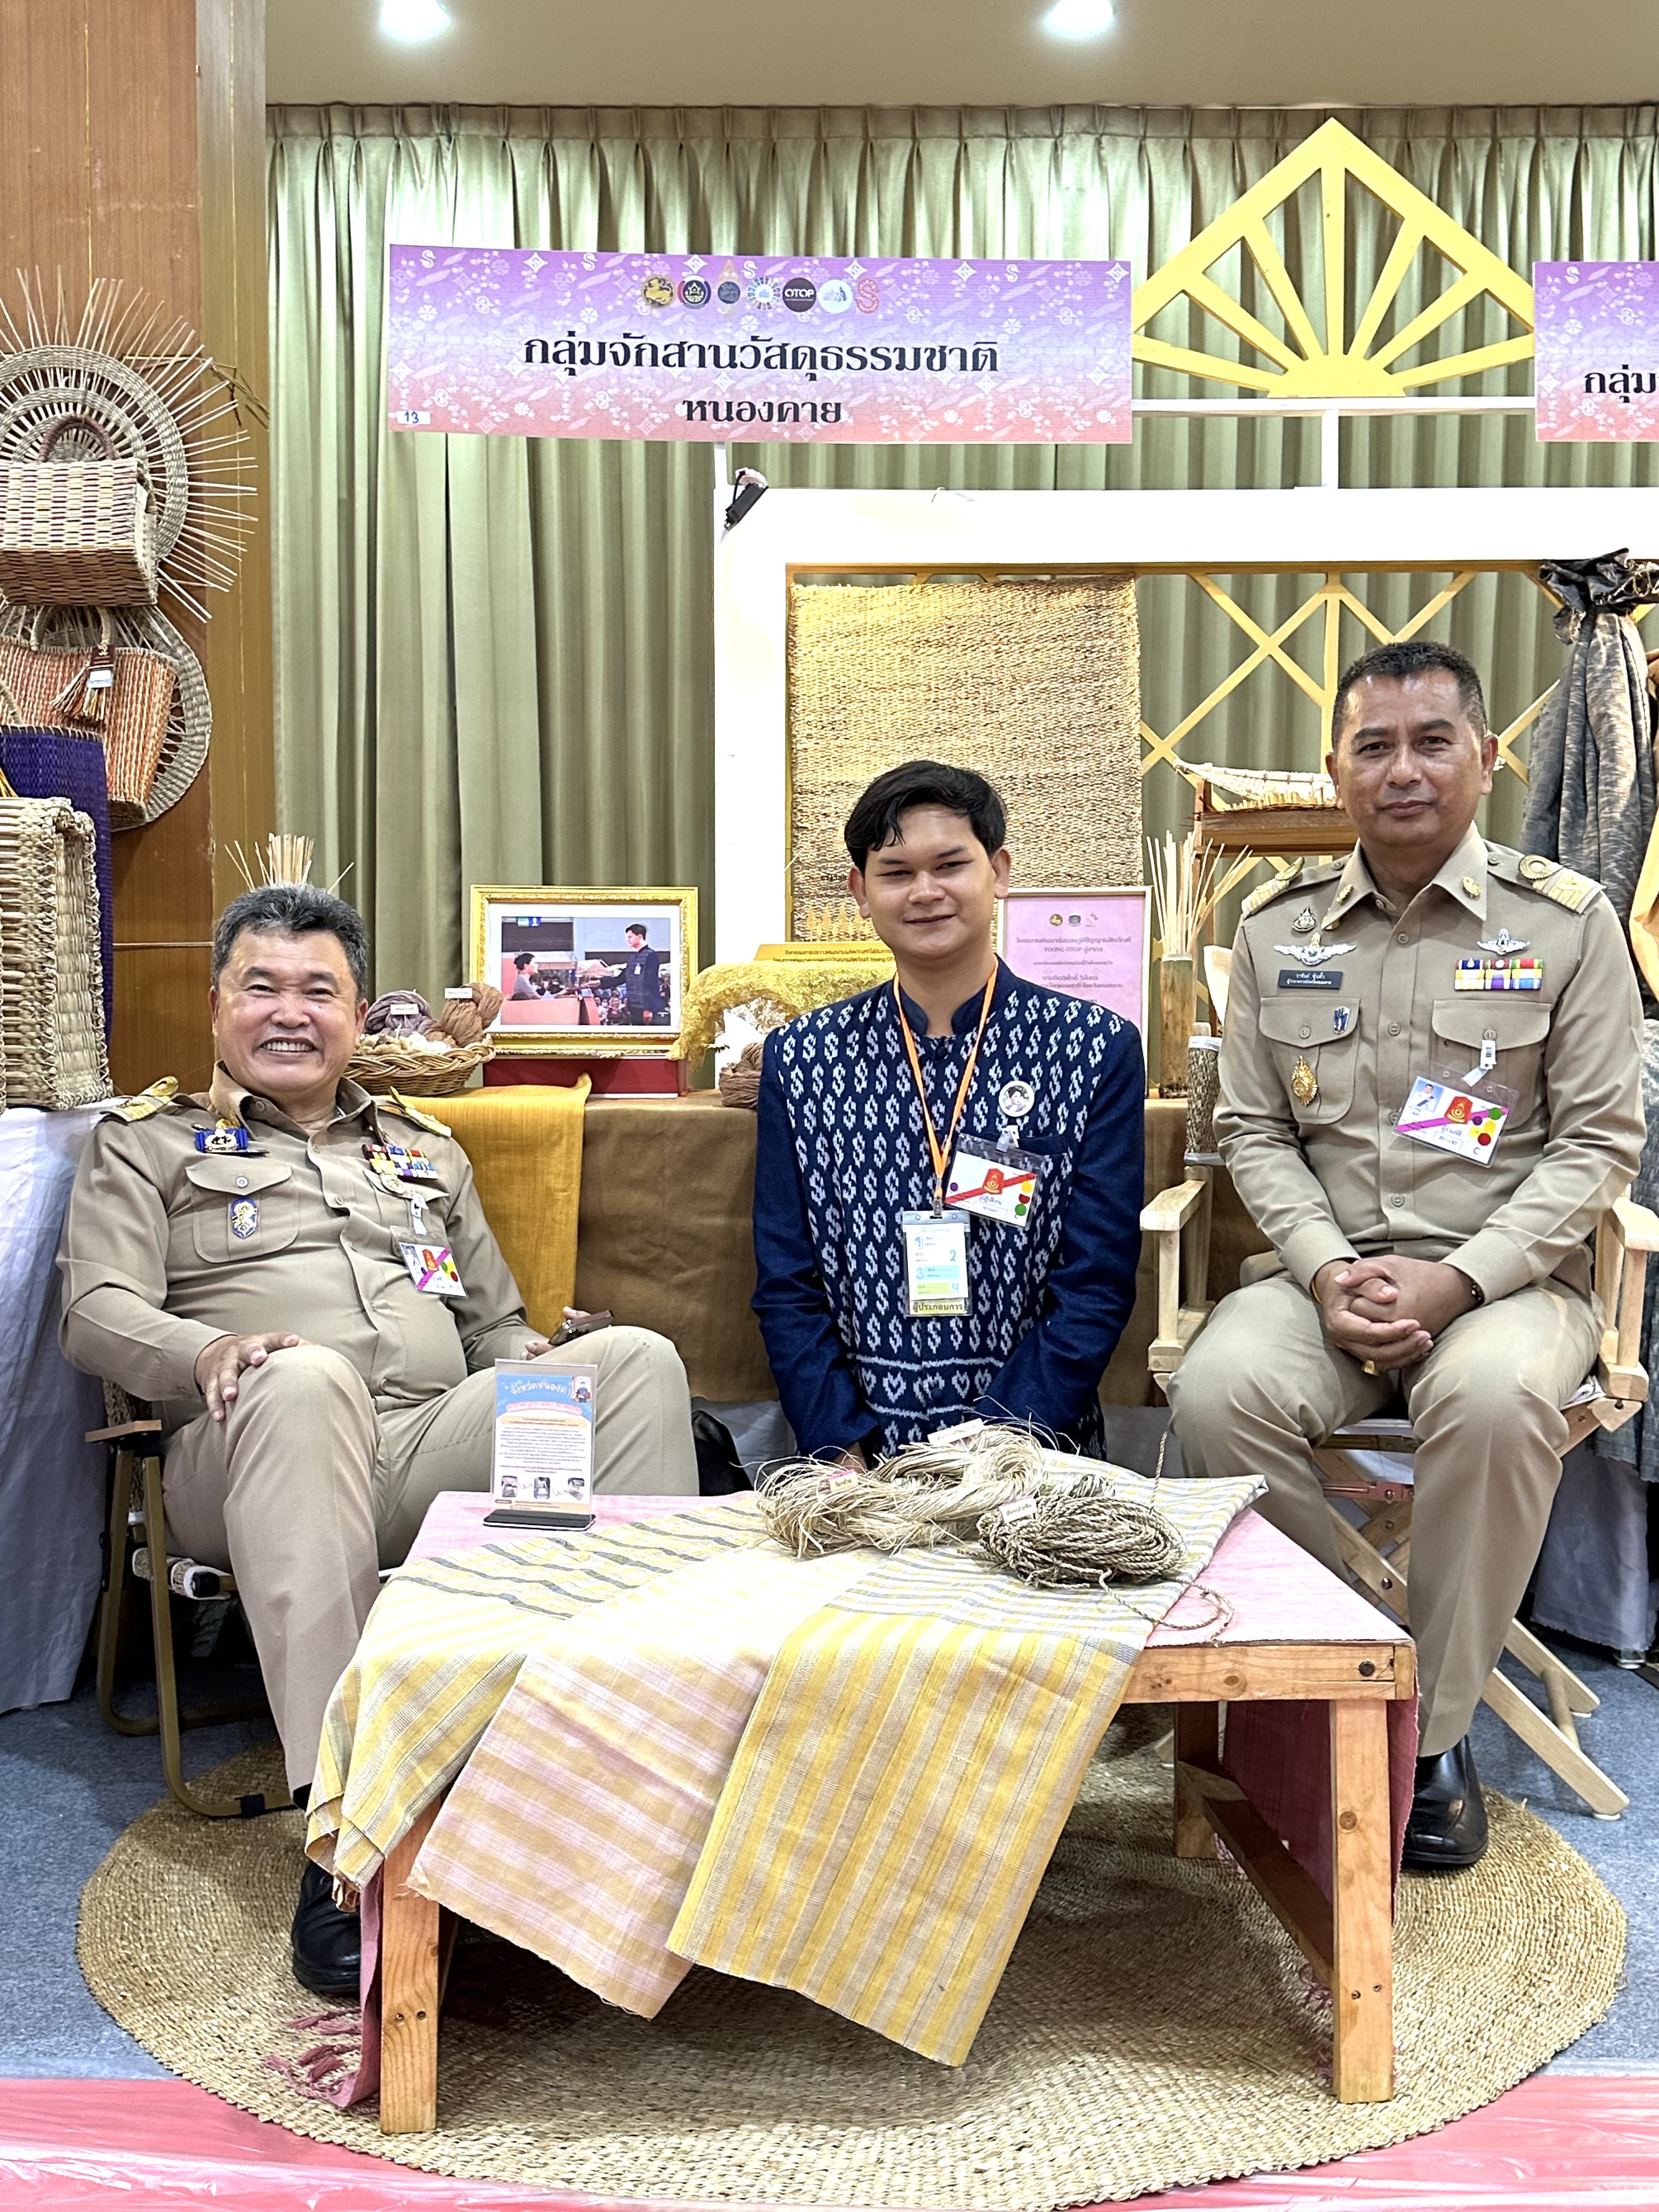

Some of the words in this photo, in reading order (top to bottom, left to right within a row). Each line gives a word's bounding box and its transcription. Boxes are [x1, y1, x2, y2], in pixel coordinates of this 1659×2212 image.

[785, 288, 814, 298] OTOP
[523, 330, 999, 382] กลุ่มจักสานวัสดุธรรมชาติ
[404, 410, 419, 424] 13
[681, 399, 842, 424] หนองคาย
[949, 1250, 957, 1262] 2
[916, 1267, 924, 1280] 3
[912, 1301, 963, 1313] ผู้ประกอบการ
